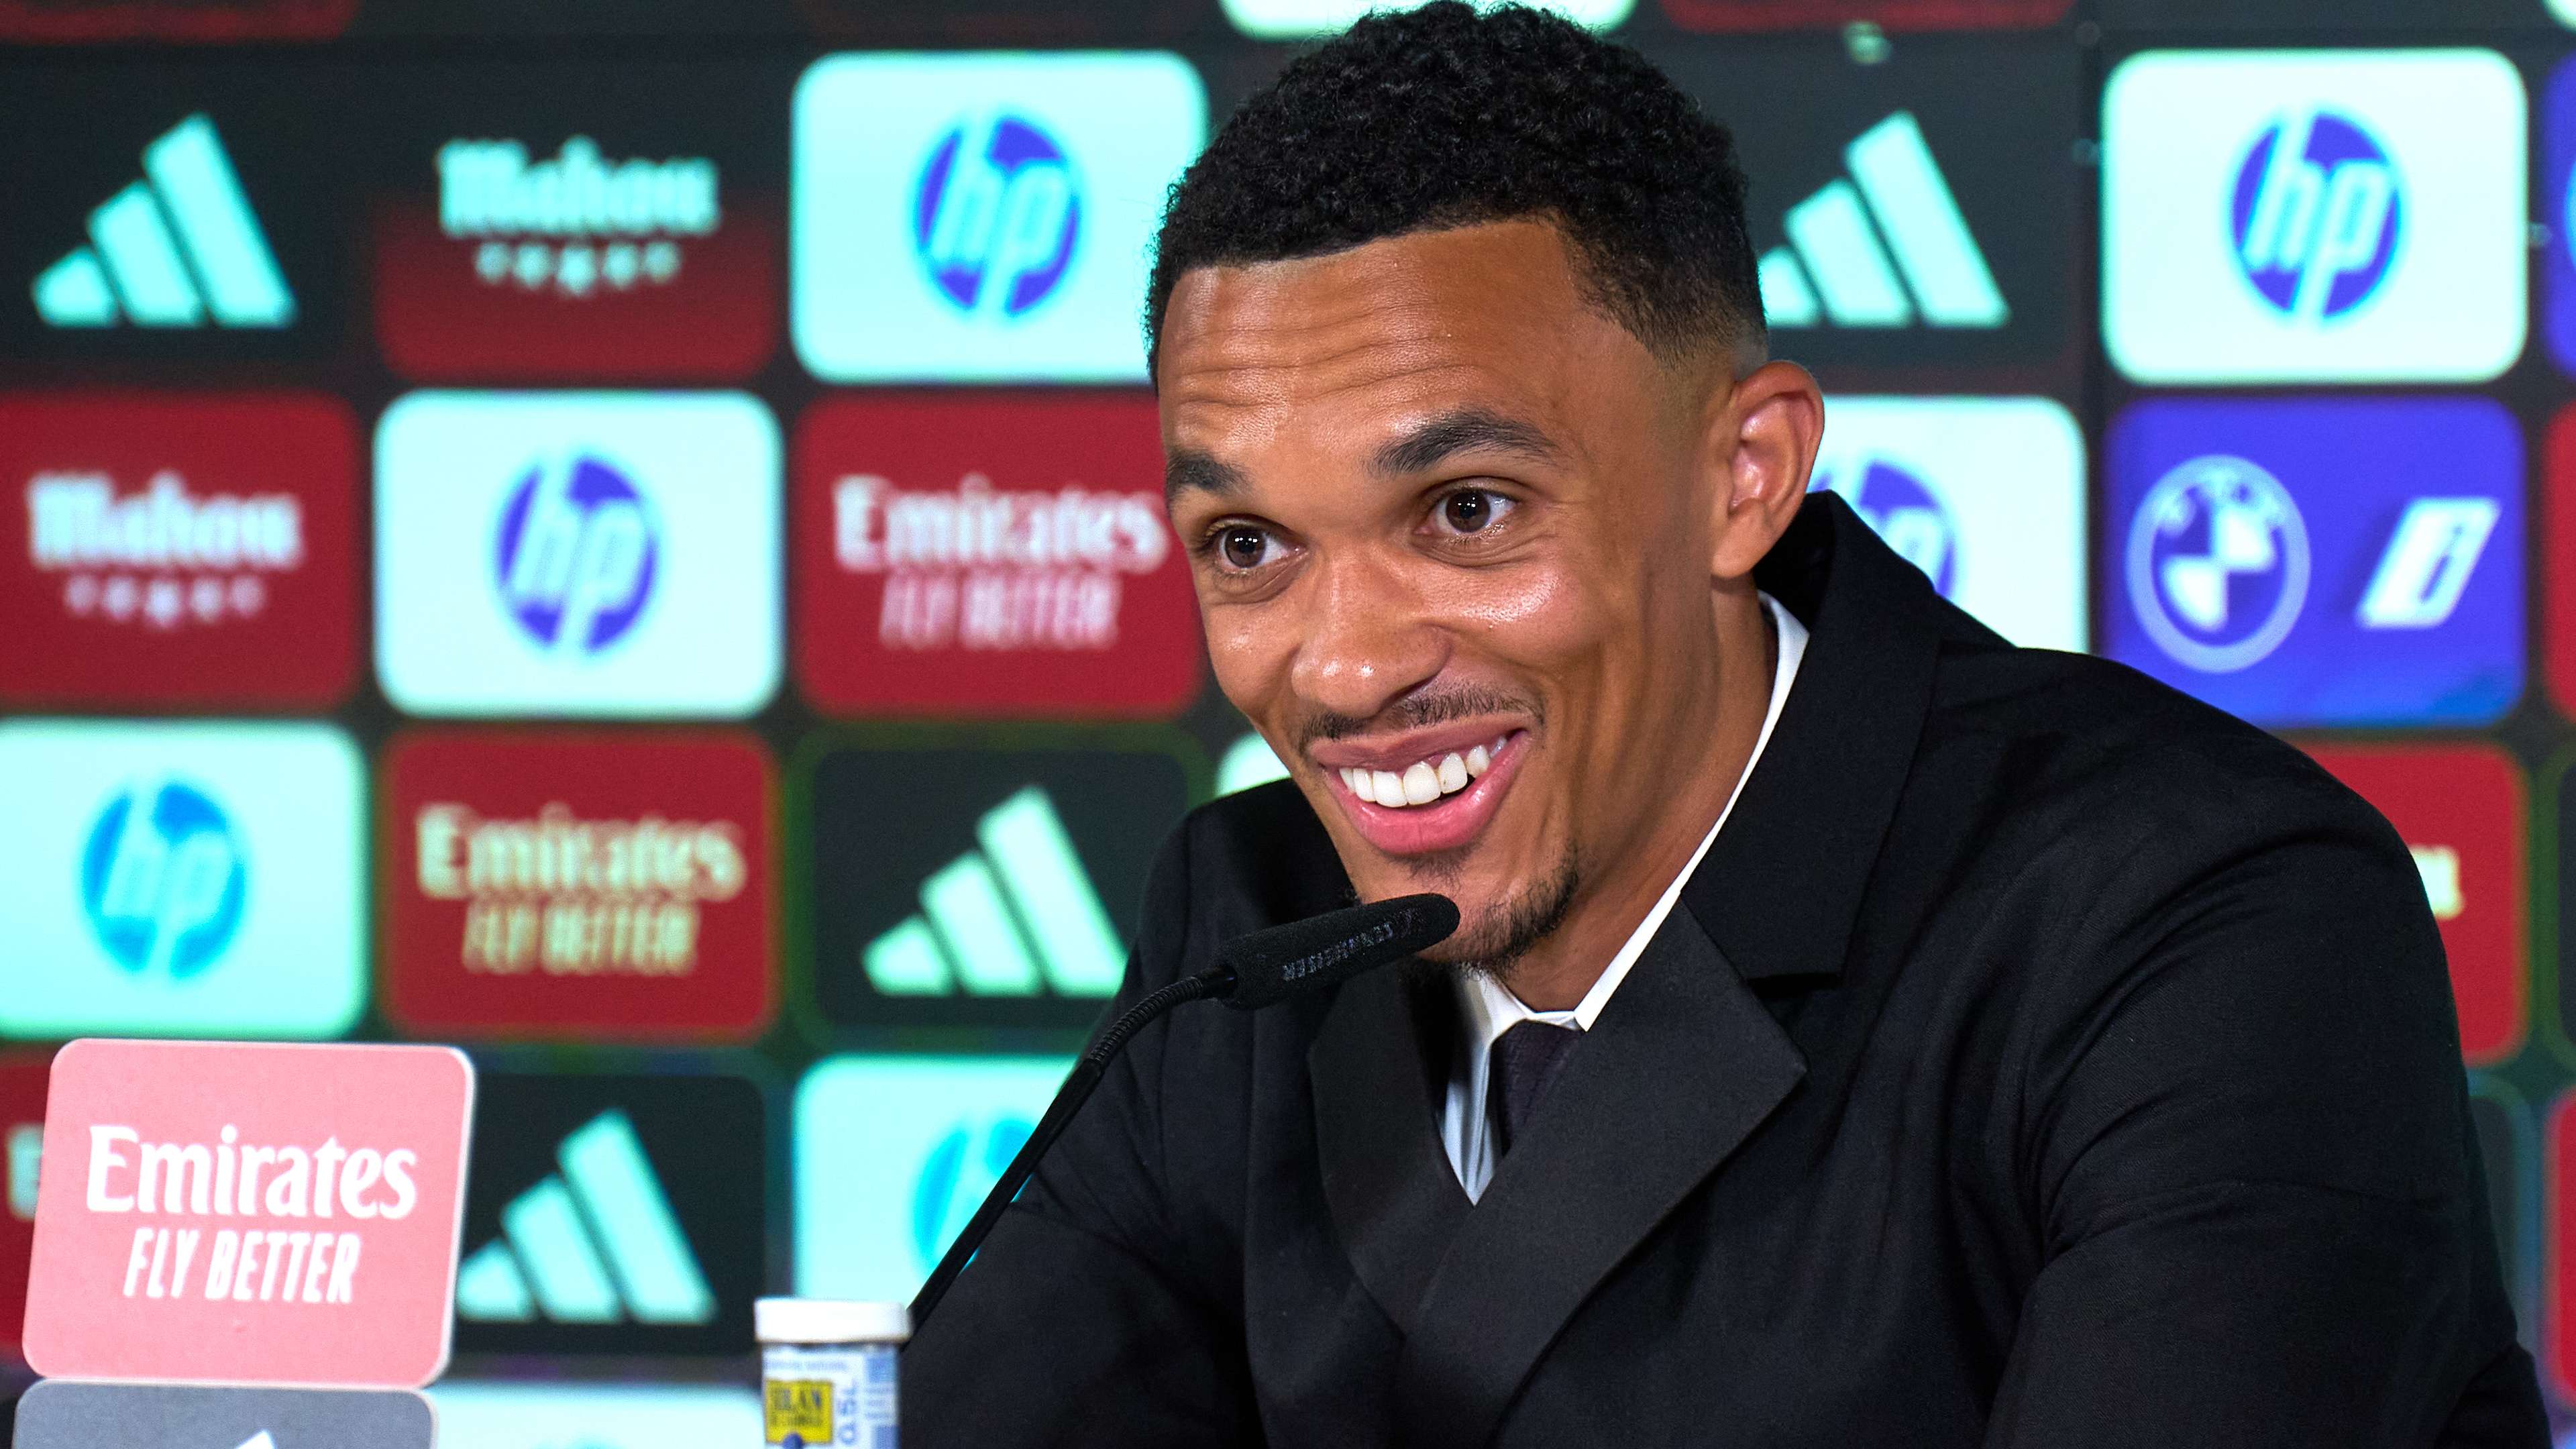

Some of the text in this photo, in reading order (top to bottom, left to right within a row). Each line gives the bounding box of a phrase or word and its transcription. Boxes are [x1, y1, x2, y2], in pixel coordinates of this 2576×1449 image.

[920, 113, 1077, 319] hp
[2234, 109, 2400, 319] hp
[500, 456, 653, 654] hp
[834, 475, 1167, 574] Emirates
[86, 780, 246, 976] hp
[417, 803, 746, 902] Emirates
[86, 1124, 417, 1220] Emirates
[123, 1227, 361, 1304] FLY BETTER
